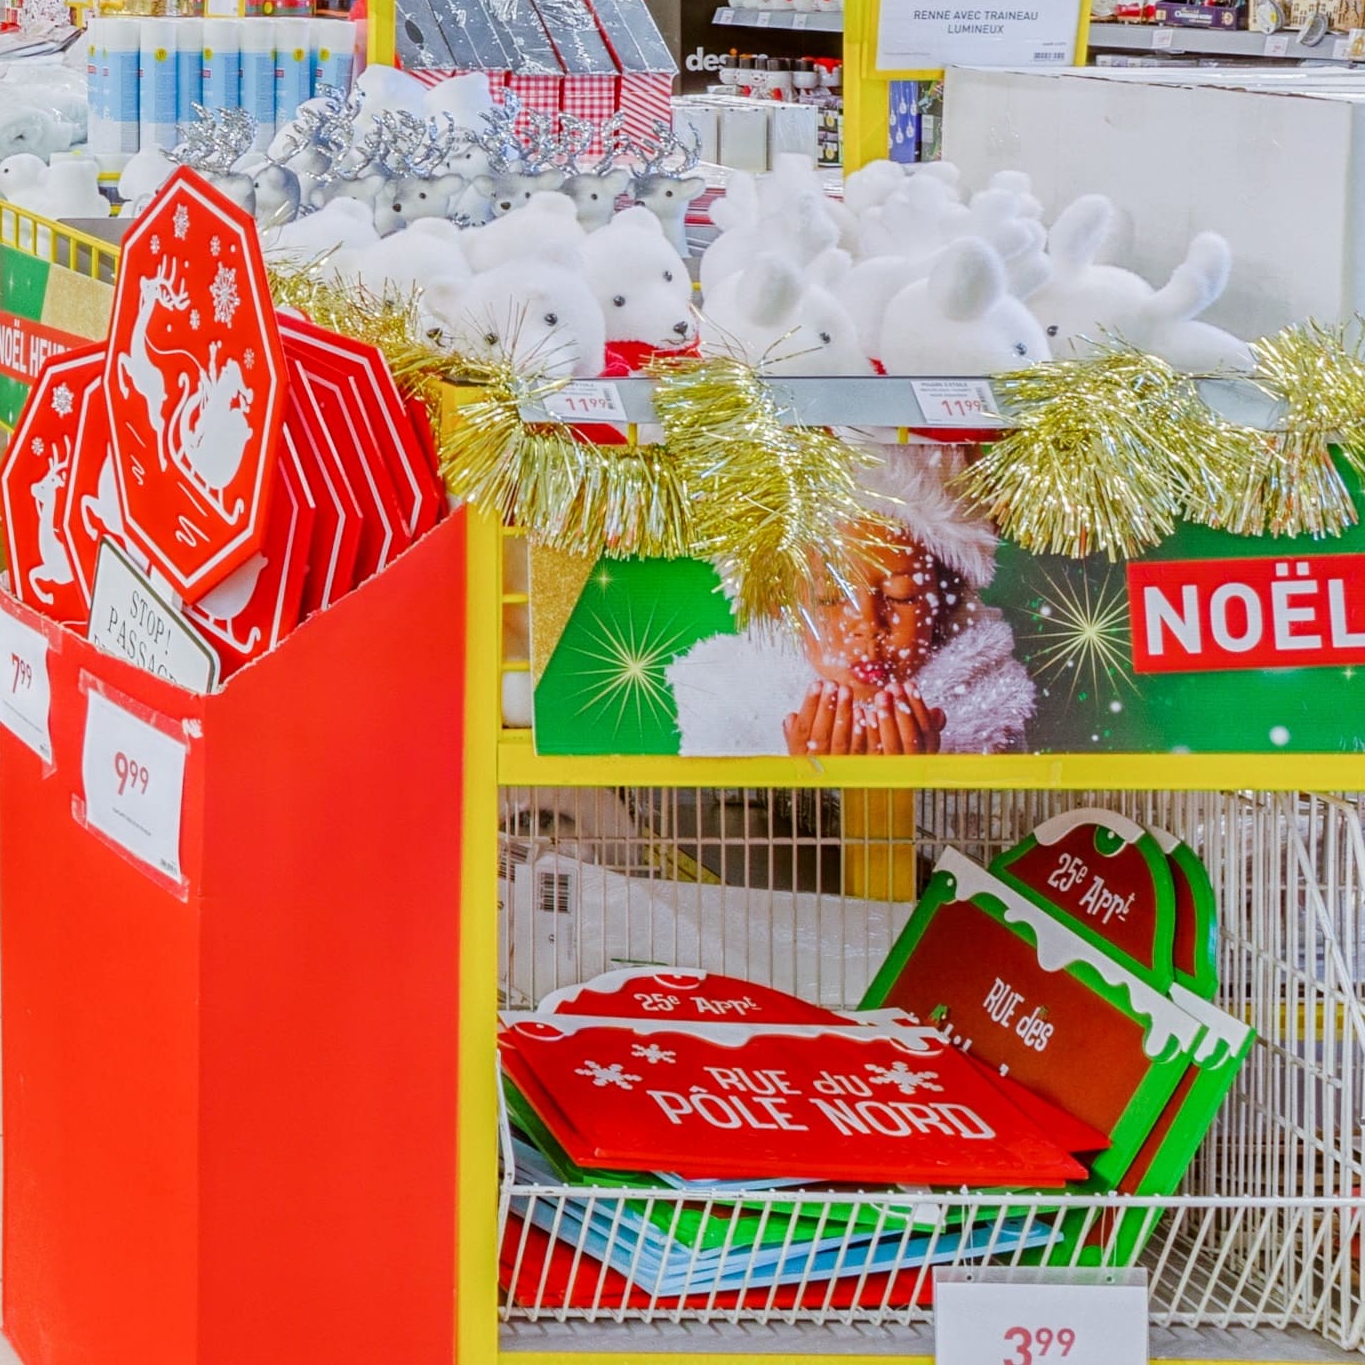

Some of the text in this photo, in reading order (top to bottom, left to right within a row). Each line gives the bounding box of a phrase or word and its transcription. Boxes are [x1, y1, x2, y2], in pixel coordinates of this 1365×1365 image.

[914, 10, 1038, 21] RENNE AVEC TRAINEAU
[947, 24, 1004, 35] LUMINEUX
[1144, 561, 1365, 655] NOËL
[983, 976, 1025, 1028] RUE
[704, 1066, 802, 1096] RUE
[647, 1084, 997, 1139] PÔLE NORD
